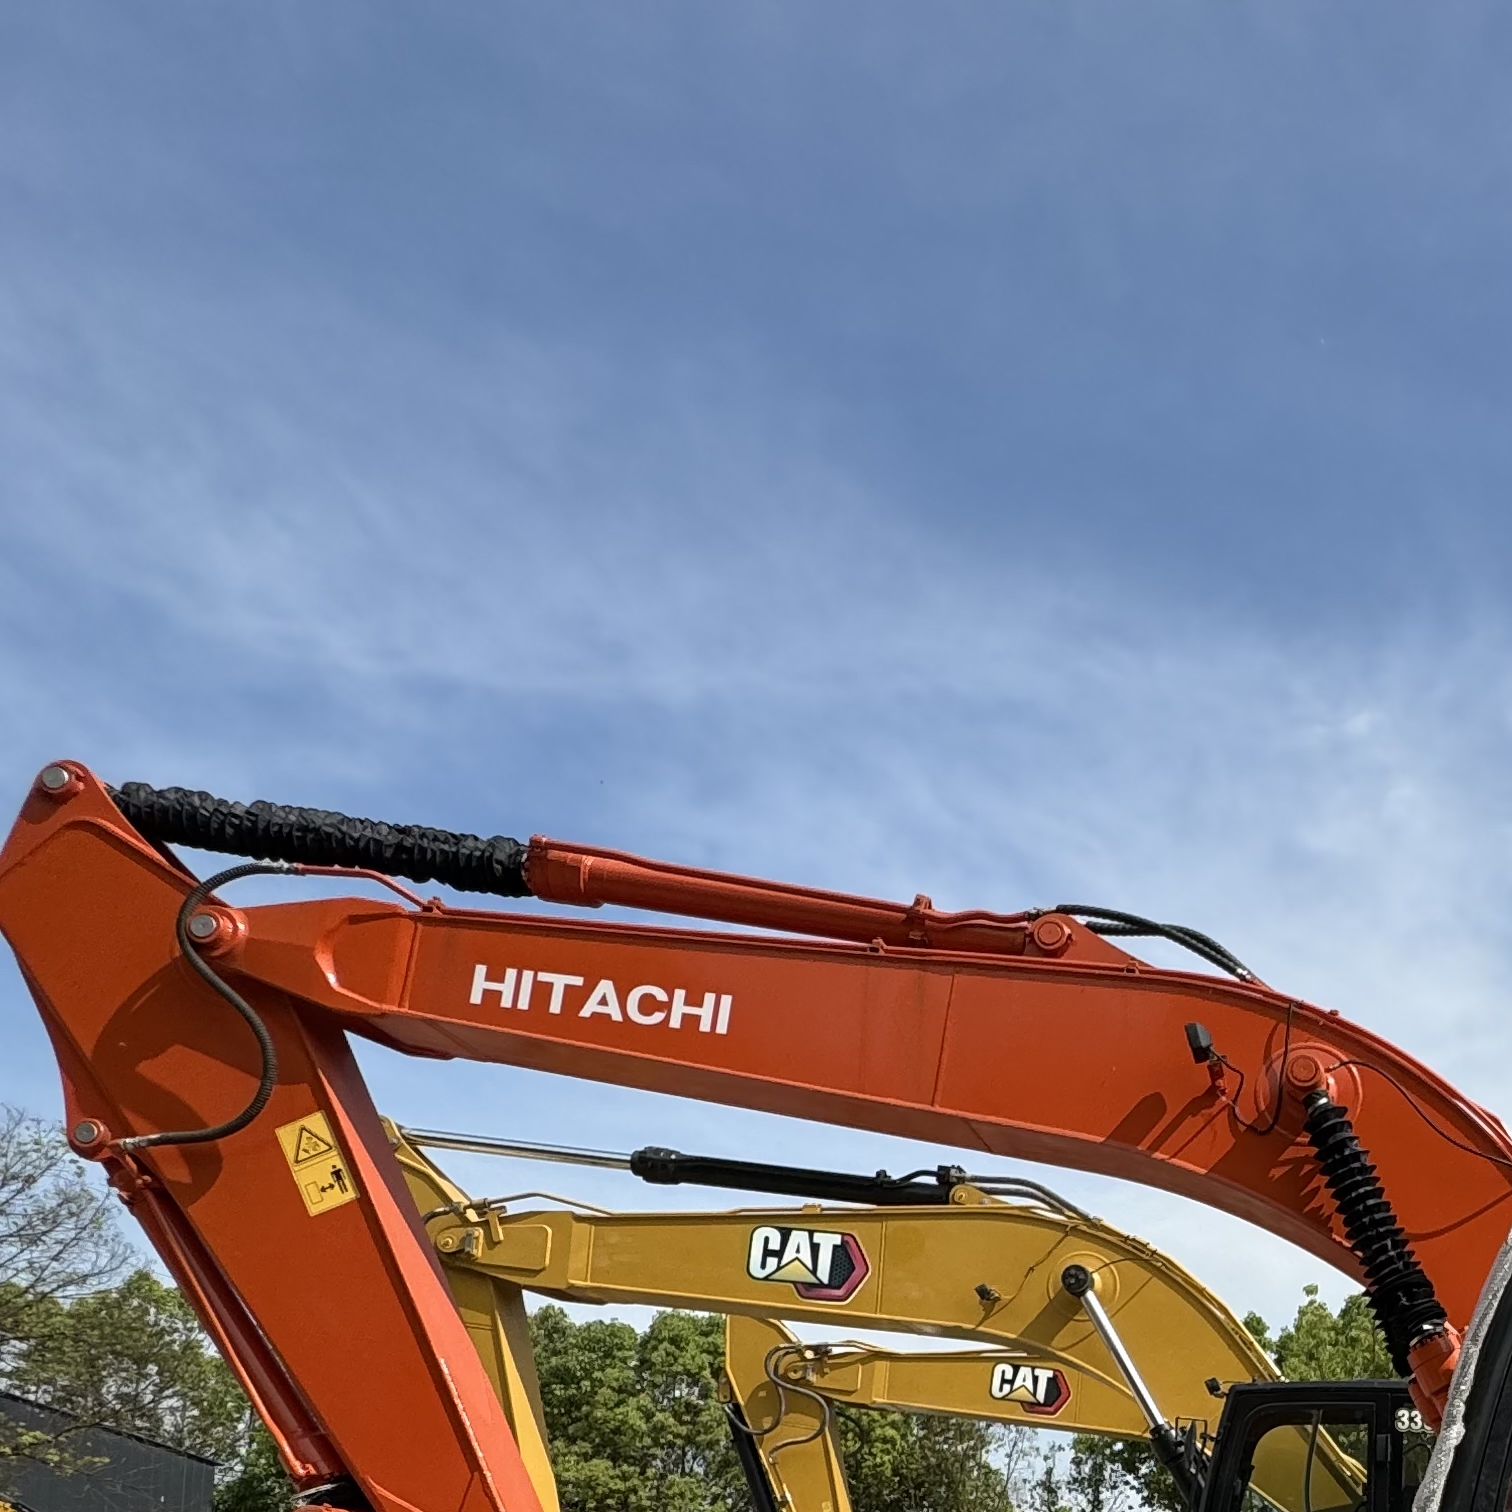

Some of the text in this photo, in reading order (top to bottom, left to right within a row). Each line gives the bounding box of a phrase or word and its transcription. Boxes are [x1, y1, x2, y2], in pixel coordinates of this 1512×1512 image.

[468, 963, 733, 1035] HITACHI
[748, 1226, 842, 1285] CAT
[991, 1362, 1055, 1404] CAT
[1395, 1408, 1433, 1431] 33
